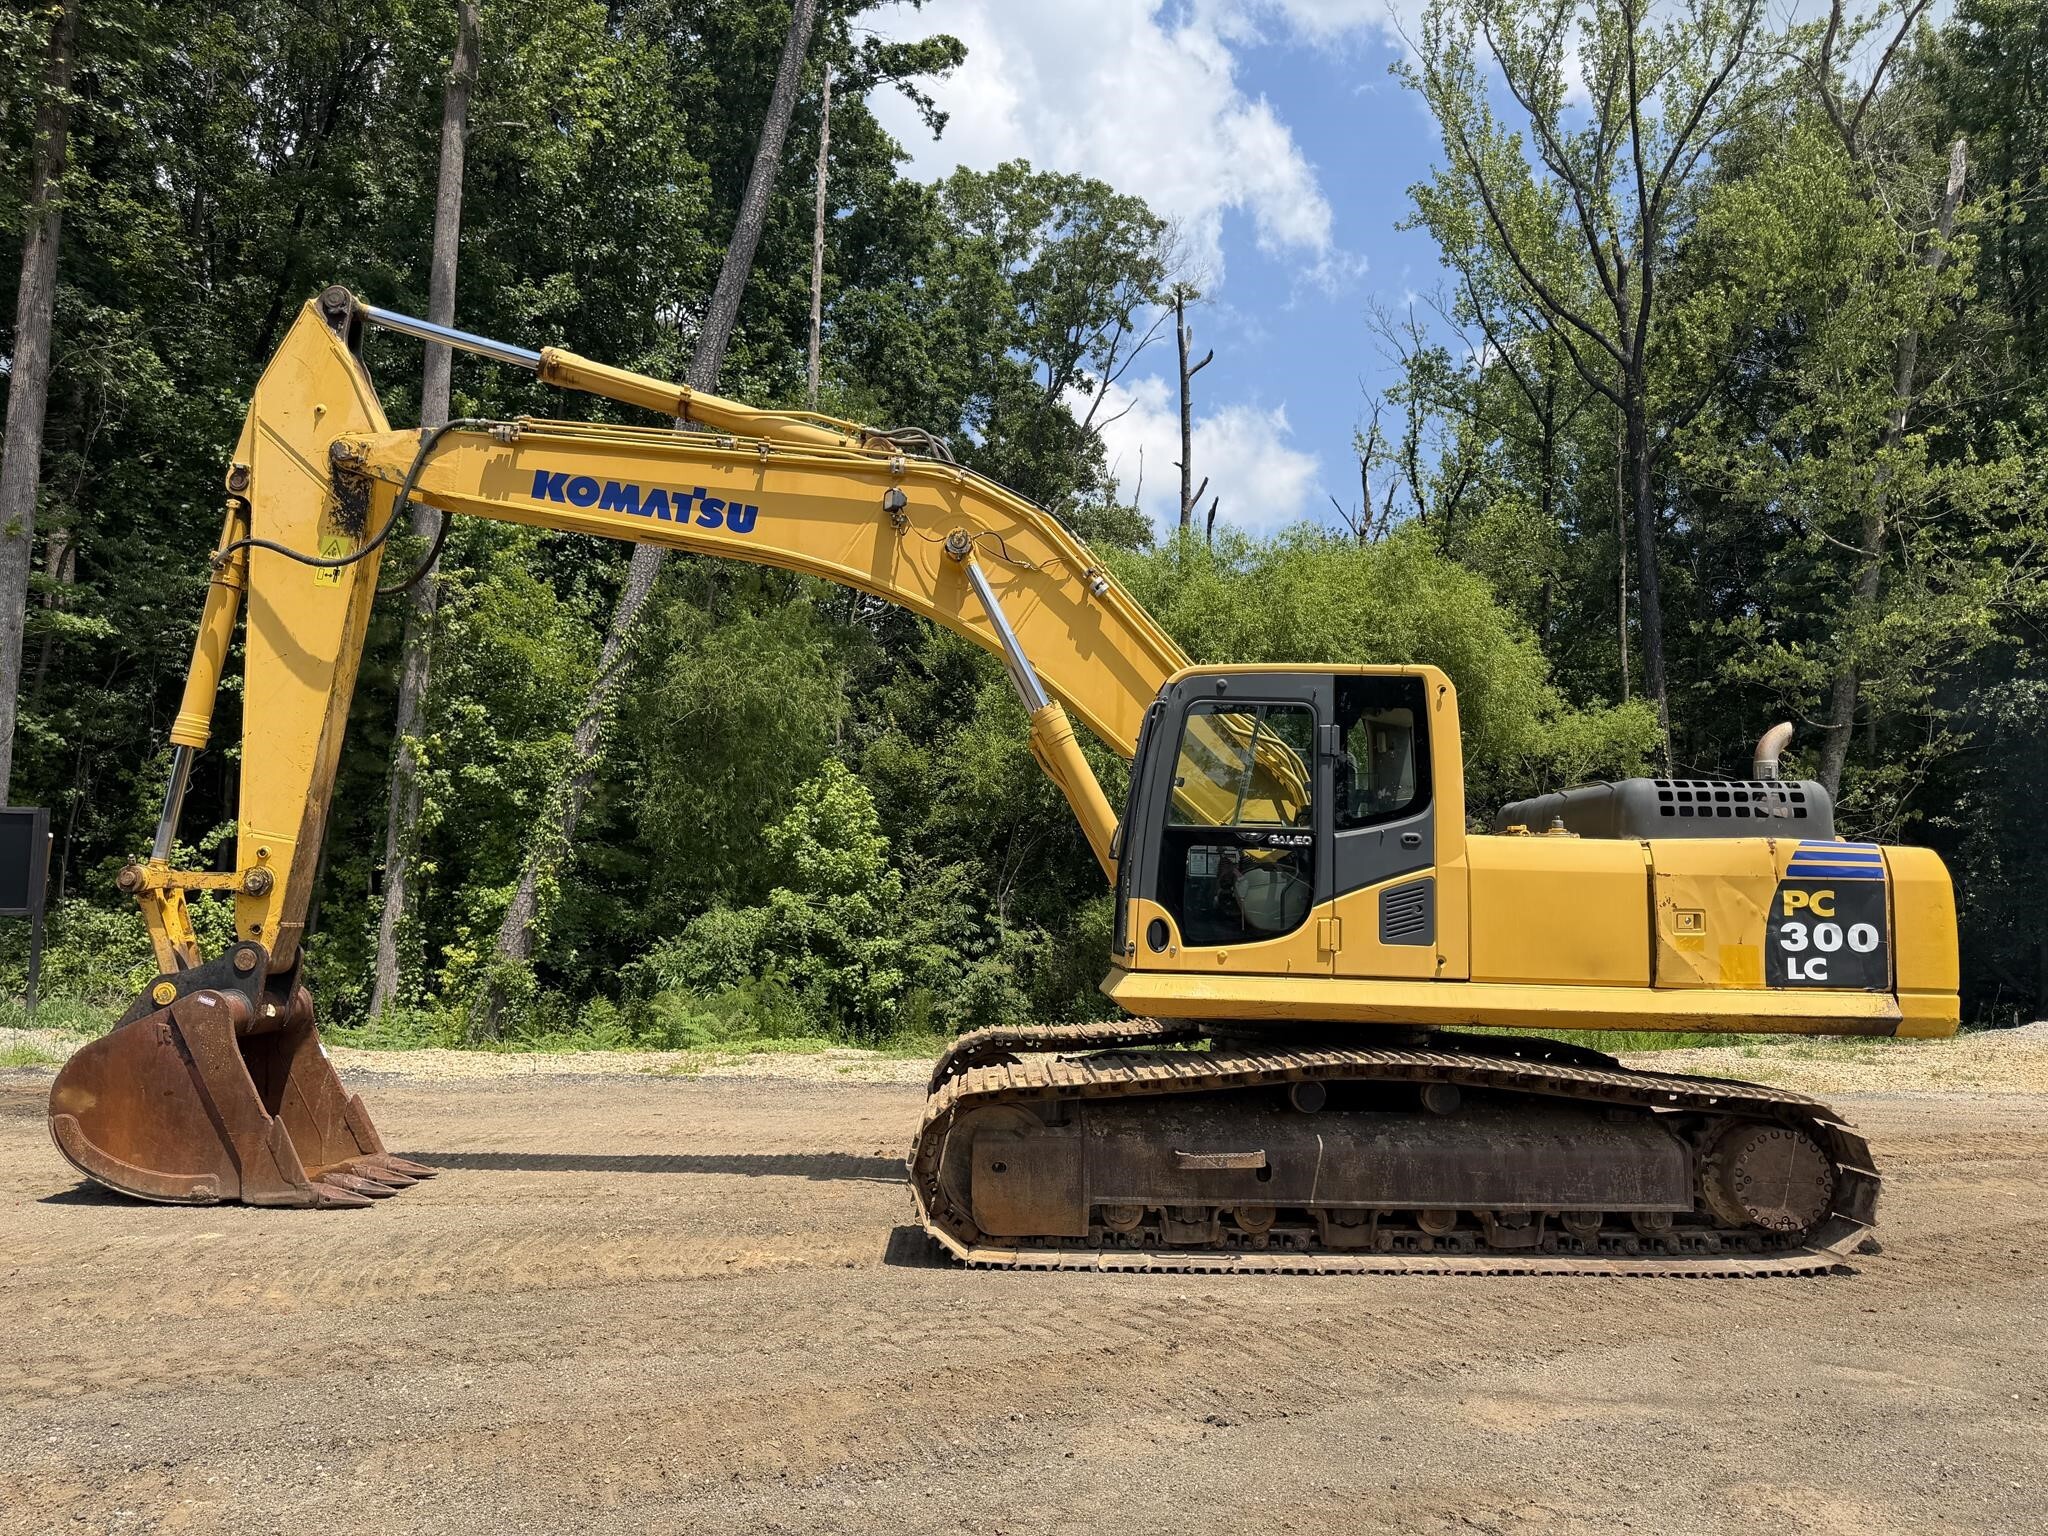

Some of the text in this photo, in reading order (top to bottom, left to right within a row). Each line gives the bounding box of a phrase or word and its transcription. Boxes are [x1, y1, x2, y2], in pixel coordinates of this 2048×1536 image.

[531, 469, 759, 534] KOMATSU
[1268, 834, 1313, 846] GALEO
[1783, 890, 1835, 917] PC
[1780, 922, 1879, 953] 300
[1787, 957, 1828, 980] LC
